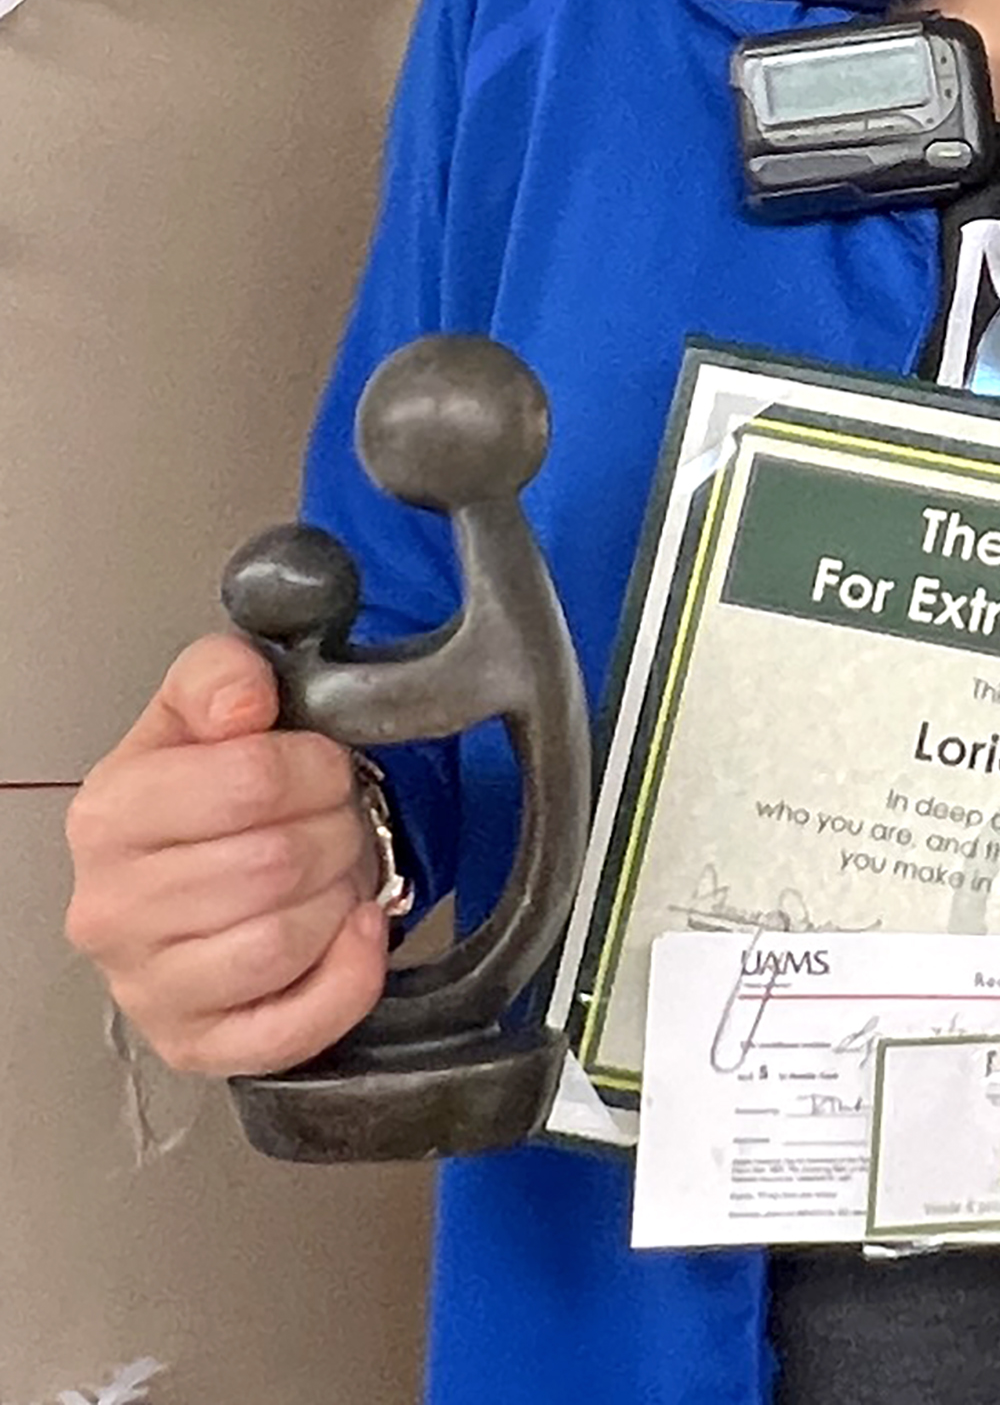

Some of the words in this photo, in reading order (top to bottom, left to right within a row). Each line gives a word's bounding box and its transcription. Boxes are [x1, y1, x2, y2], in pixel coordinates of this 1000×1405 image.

[811, 557, 895, 613] For
[756, 799, 810, 825] who
[816, 812, 864, 836] you
[926, 833, 978, 859] and
[886, 789, 908, 813] In
[915, 796, 983, 827] deep
[840, 849, 888, 874] you
[893, 859, 966, 890] make
[970, 871, 993, 893] in
[740, 950, 831, 975] UAMS
